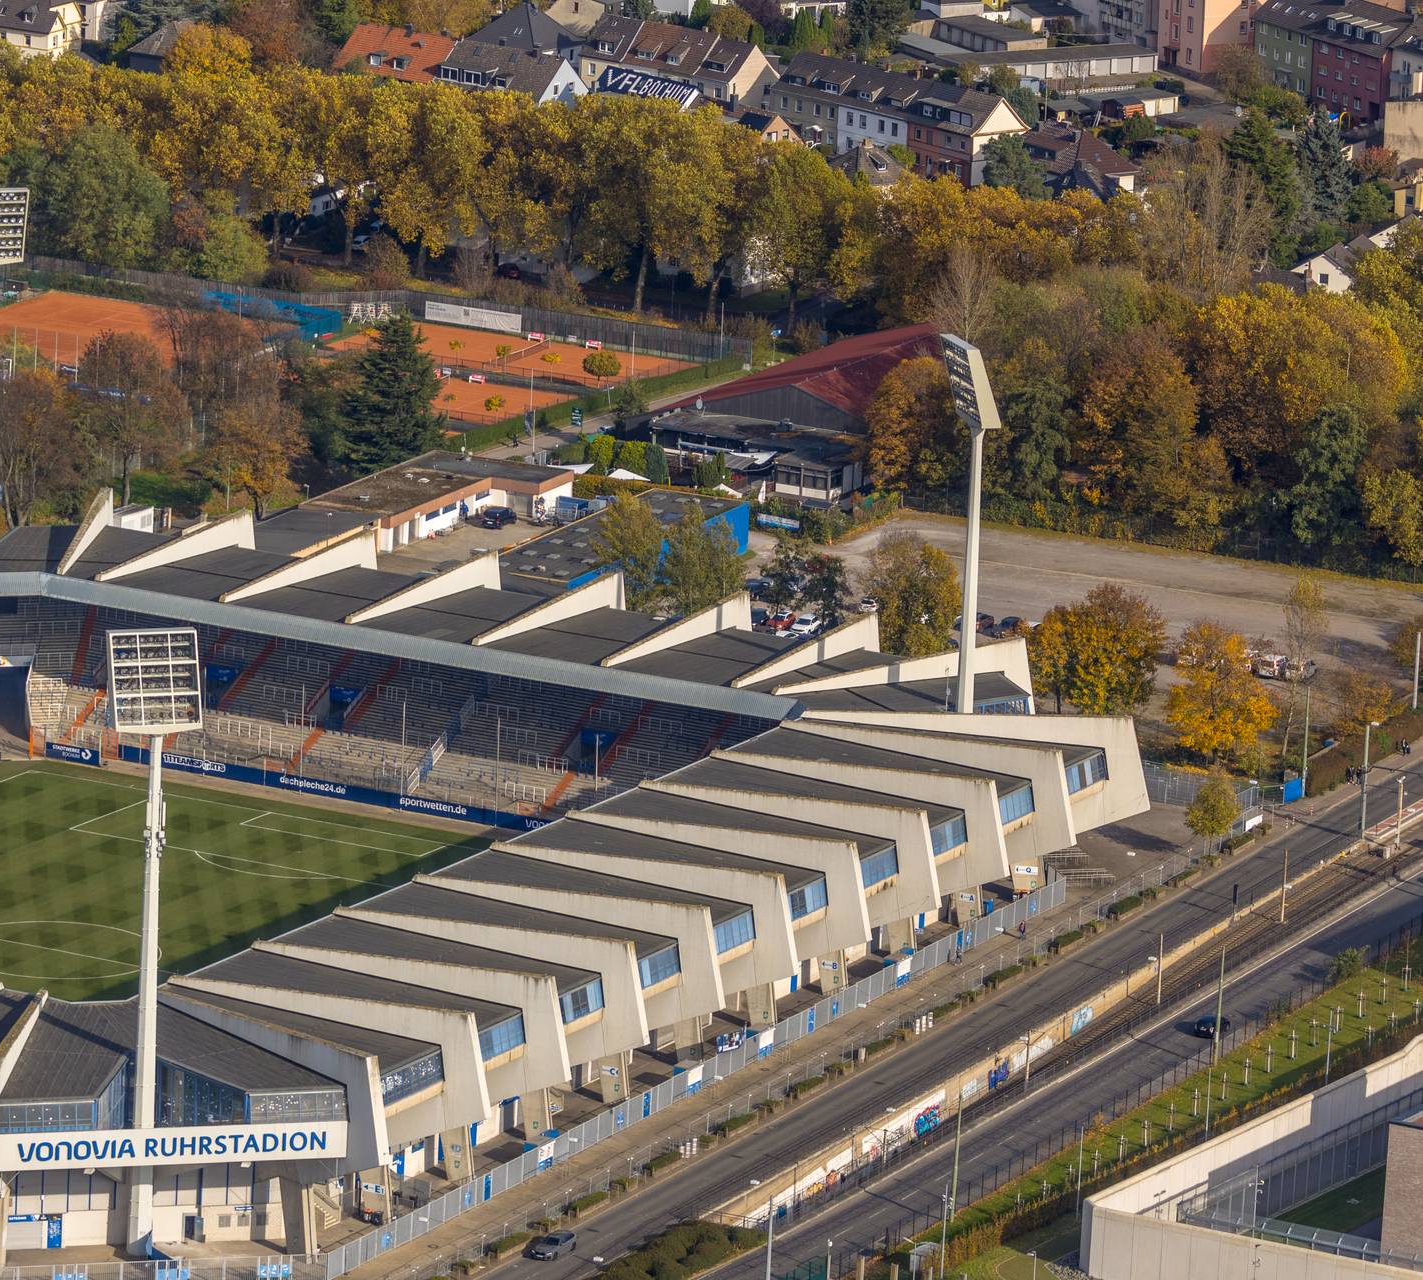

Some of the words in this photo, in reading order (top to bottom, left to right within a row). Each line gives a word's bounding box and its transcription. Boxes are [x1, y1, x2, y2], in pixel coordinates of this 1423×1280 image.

[638, 78, 692, 104] BOCHUM
[52, 744, 81, 755] STADTWERKE
[62, 751, 81, 759] BOCHUM
[399, 796, 467, 816] sportwetten.de
[144, 1131, 327, 1157] RUHRSTADION
